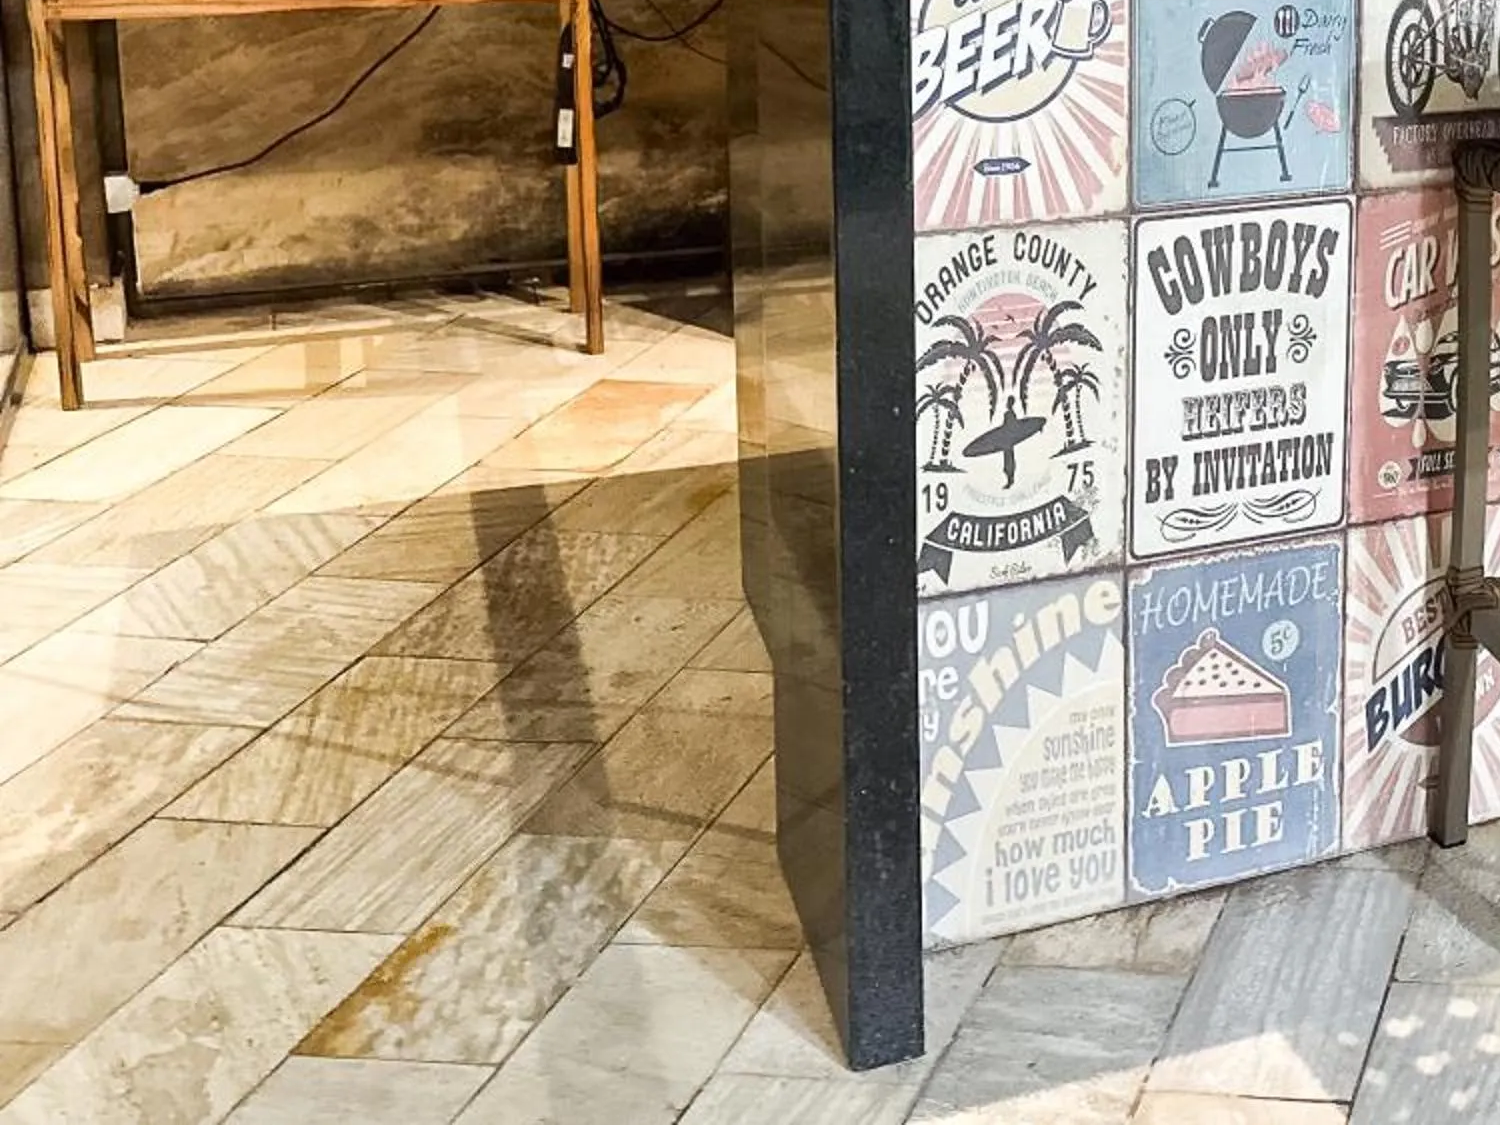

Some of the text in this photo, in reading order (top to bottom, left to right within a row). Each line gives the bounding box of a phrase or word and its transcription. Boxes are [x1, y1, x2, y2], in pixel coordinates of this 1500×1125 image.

[914, 234, 998, 326] ORANGE
[1013, 232, 1098, 302] COUNTY
[1147, 219, 1338, 315] COWBOYS
[1386, 237, 1442, 309] CAR
[1201, 309, 1282, 382] ONLY
[1181, 382, 1307, 441] HEIFERS
[921, 460, 1094, 513] 19 75
[1145, 432, 1334, 503] BY INVITATION
[948, 502, 1066, 548] CALIFORNIA
[1141, 561, 1329, 635] HOMEMADE
[919, 667, 958, 704] re
[1043, 725, 1115, 761] sunshine
[1142, 739, 1324, 818] APPLE
[995, 837, 1045, 867] how
[1053, 818, 1115, 855] much
[1185, 801, 1285, 862] PIE
[986, 868, 994, 907] i
[1005, 862, 1060, 904] love
[1069, 849, 1116, 889] you
